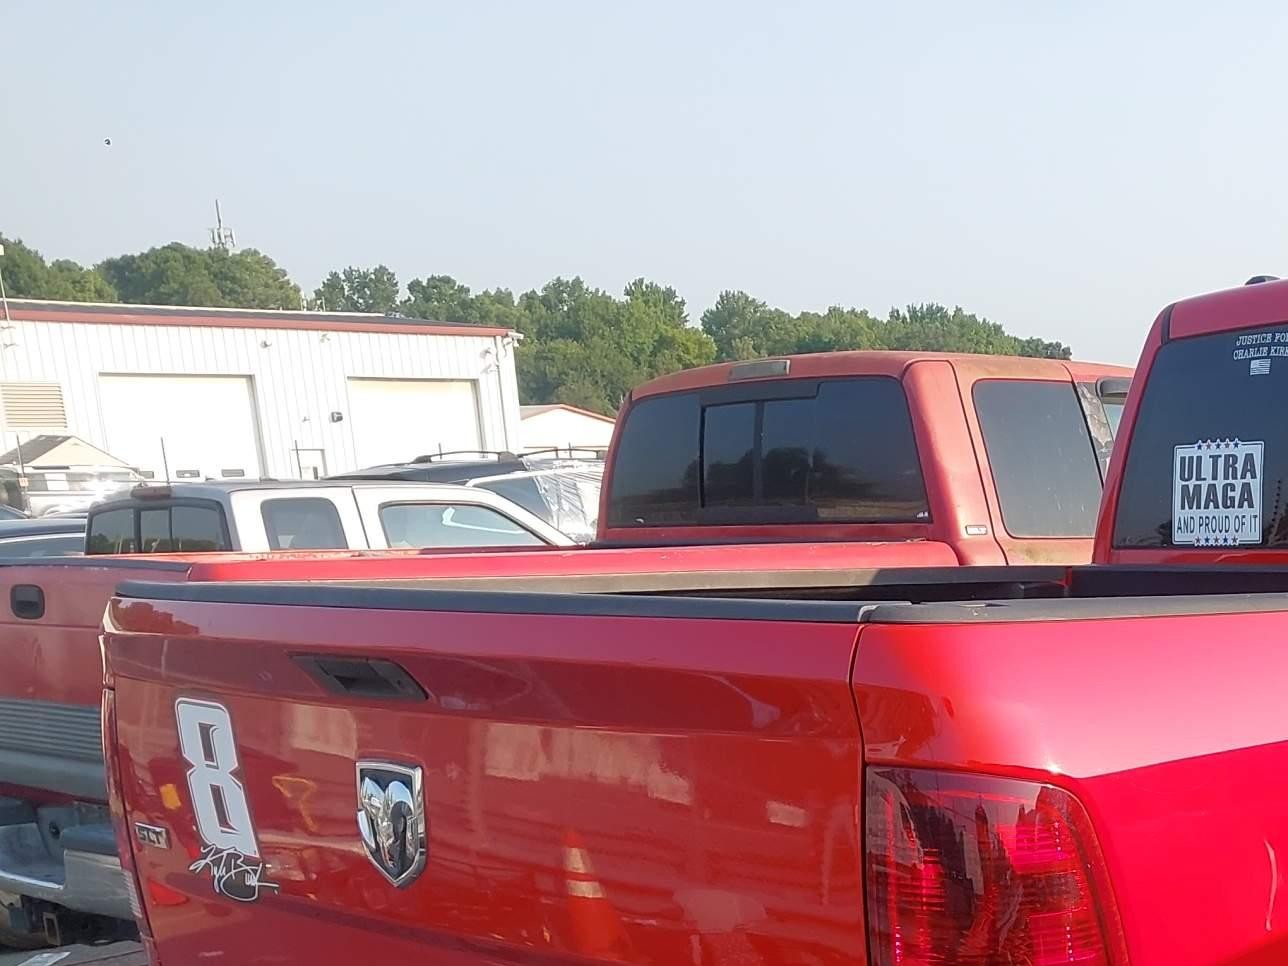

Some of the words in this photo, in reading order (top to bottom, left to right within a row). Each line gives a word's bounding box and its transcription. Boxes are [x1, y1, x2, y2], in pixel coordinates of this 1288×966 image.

[1236, 333, 1272, 346] JUSTICE
[1233, 346, 1269, 360] CHARLIE
[1179, 453, 1257, 482] ULTRA
[1180, 482, 1254, 511] MAGA
[1176, 515, 1195, 534] AND
[1198, 515, 1230, 534] PROUD
[1233, 514, 1246, 533] OF
[1249, 514, 1258, 533] IT
[175, 697, 261, 859] 8
[137, 826, 163, 847] SLT
